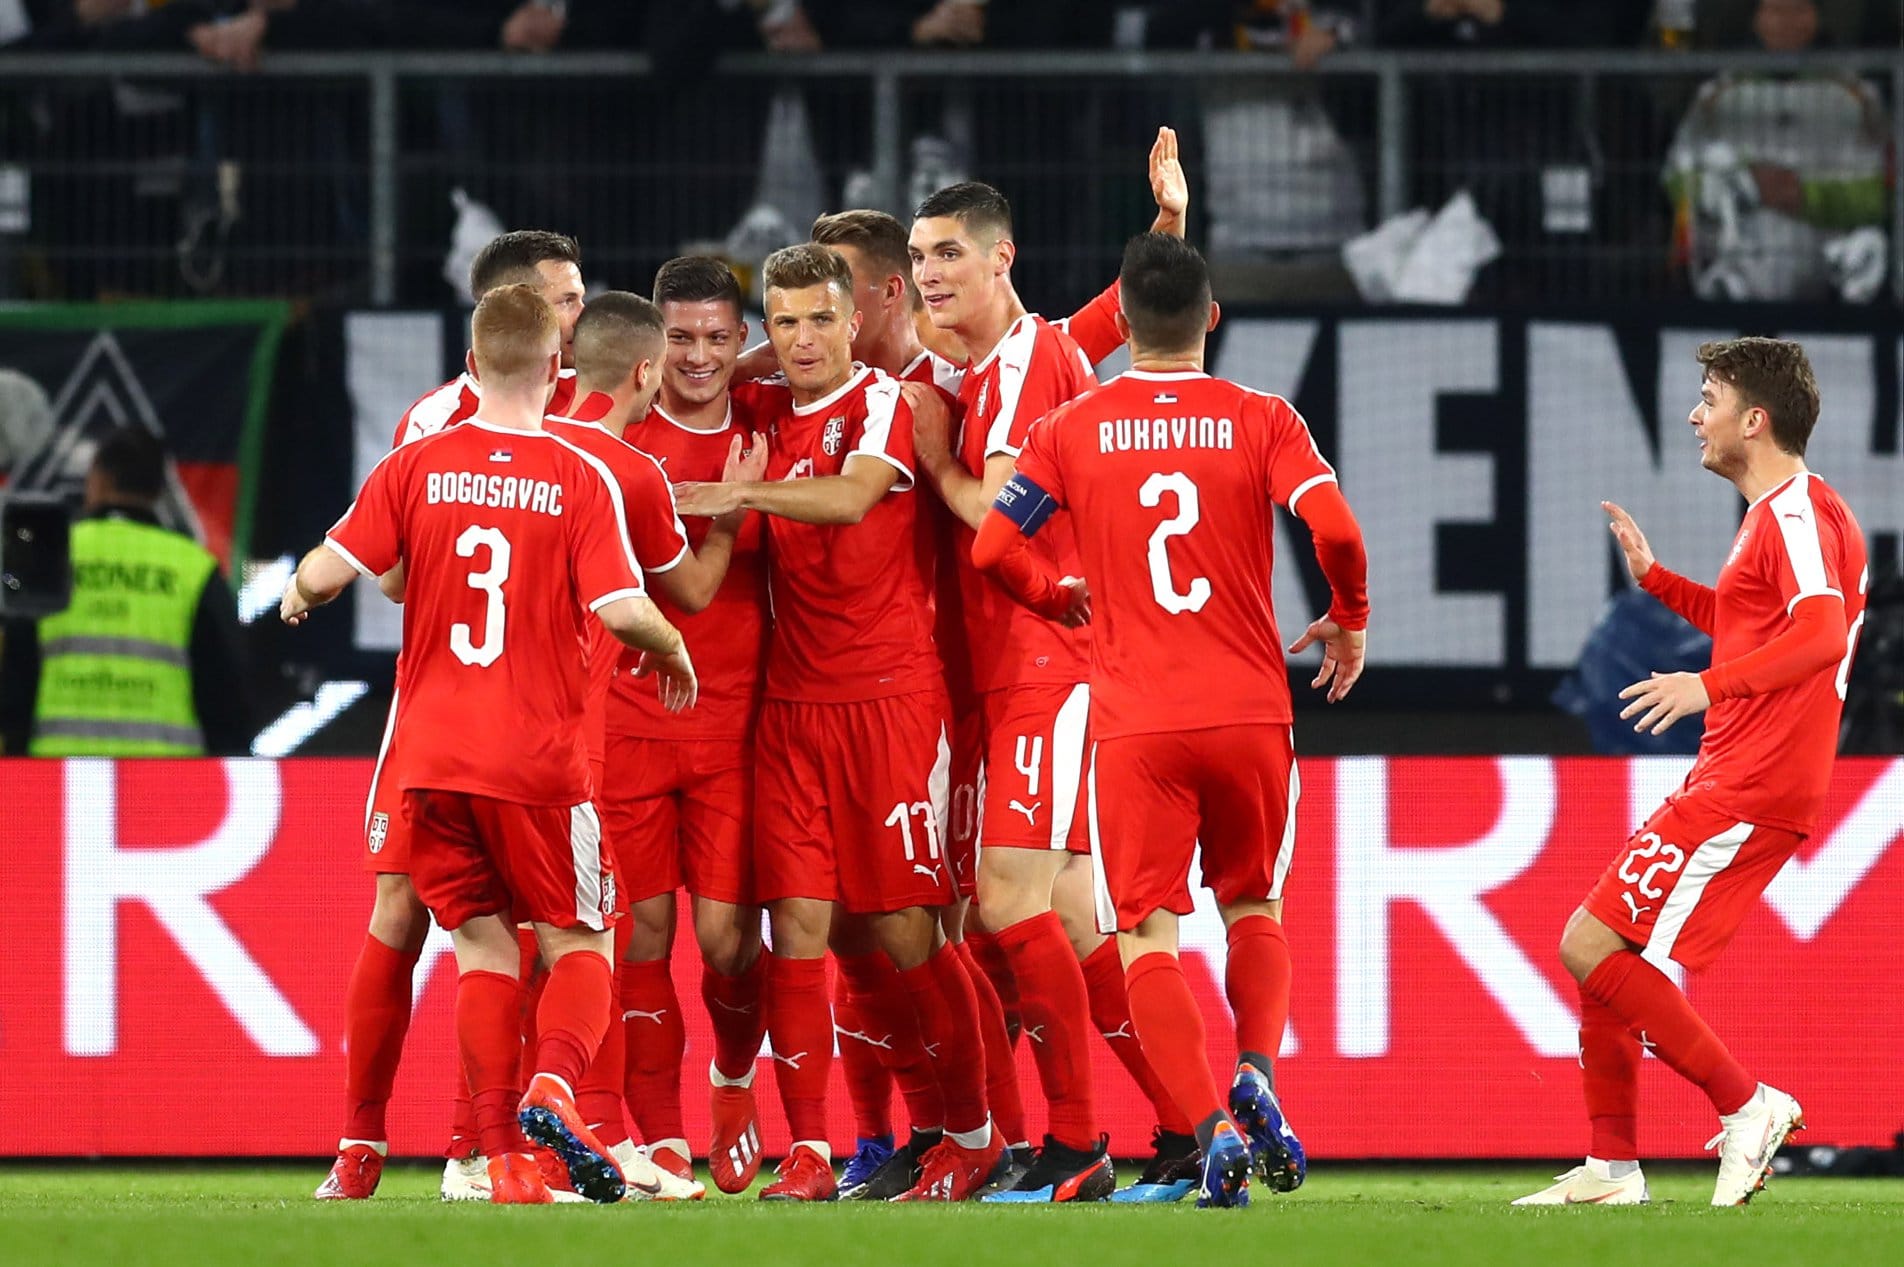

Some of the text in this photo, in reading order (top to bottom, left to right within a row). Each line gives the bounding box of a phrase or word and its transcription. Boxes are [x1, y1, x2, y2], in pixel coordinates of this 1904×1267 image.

[1099, 416, 1233, 454] RUKAVINA
[426, 471, 564, 517] BOGOSAVAC
[1138, 471, 1213, 615] 2
[449, 524, 512, 668] 3
[1014, 735, 1044, 796] 4
[884, 801, 940, 861] 17
[1617, 831, 1686, 901] 22
